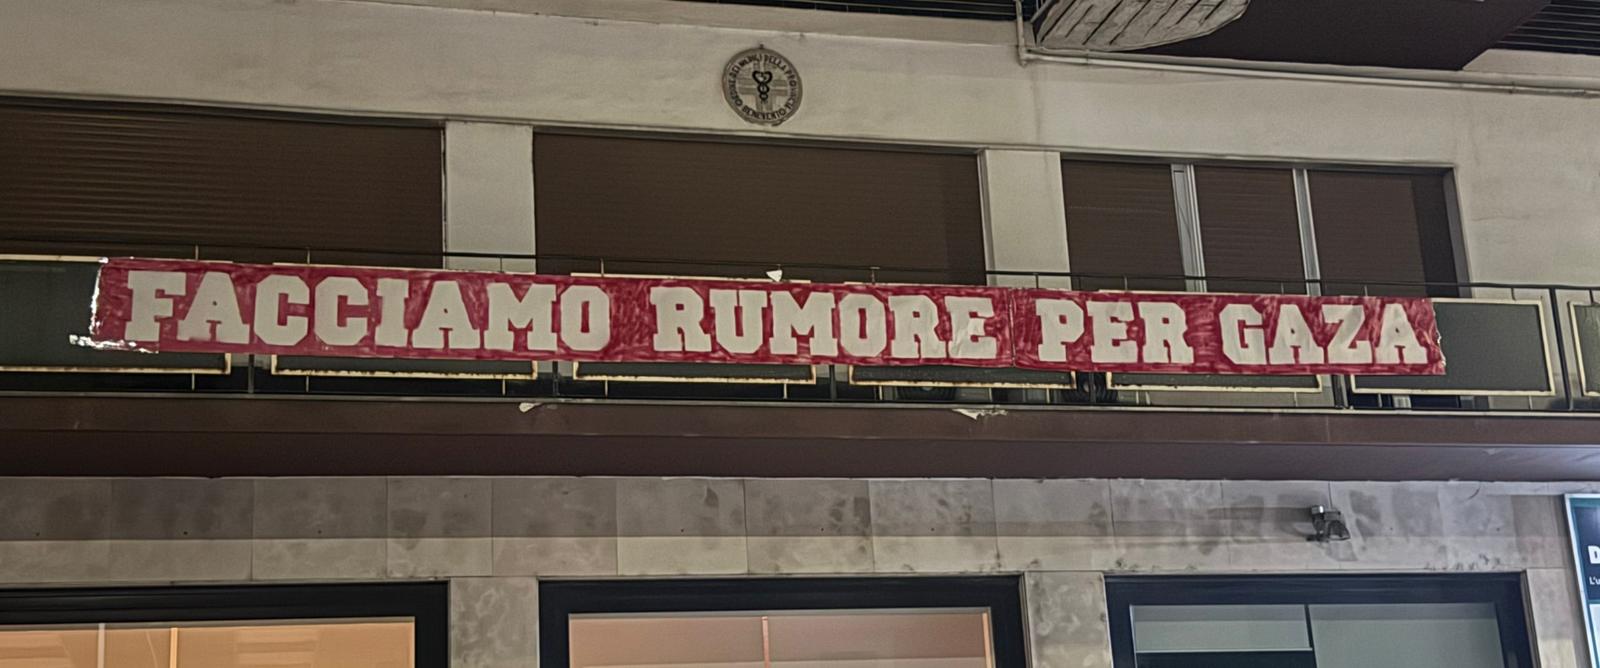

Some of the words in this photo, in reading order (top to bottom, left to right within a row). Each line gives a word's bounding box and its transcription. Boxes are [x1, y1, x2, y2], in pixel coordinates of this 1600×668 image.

[127, 269, 612, 353] FACCIAMO
[649, 284, 998, 360] RUMORE
[1036, 297, 1195, 364] PER
[1218, 302, 1430, 365] GAZA
